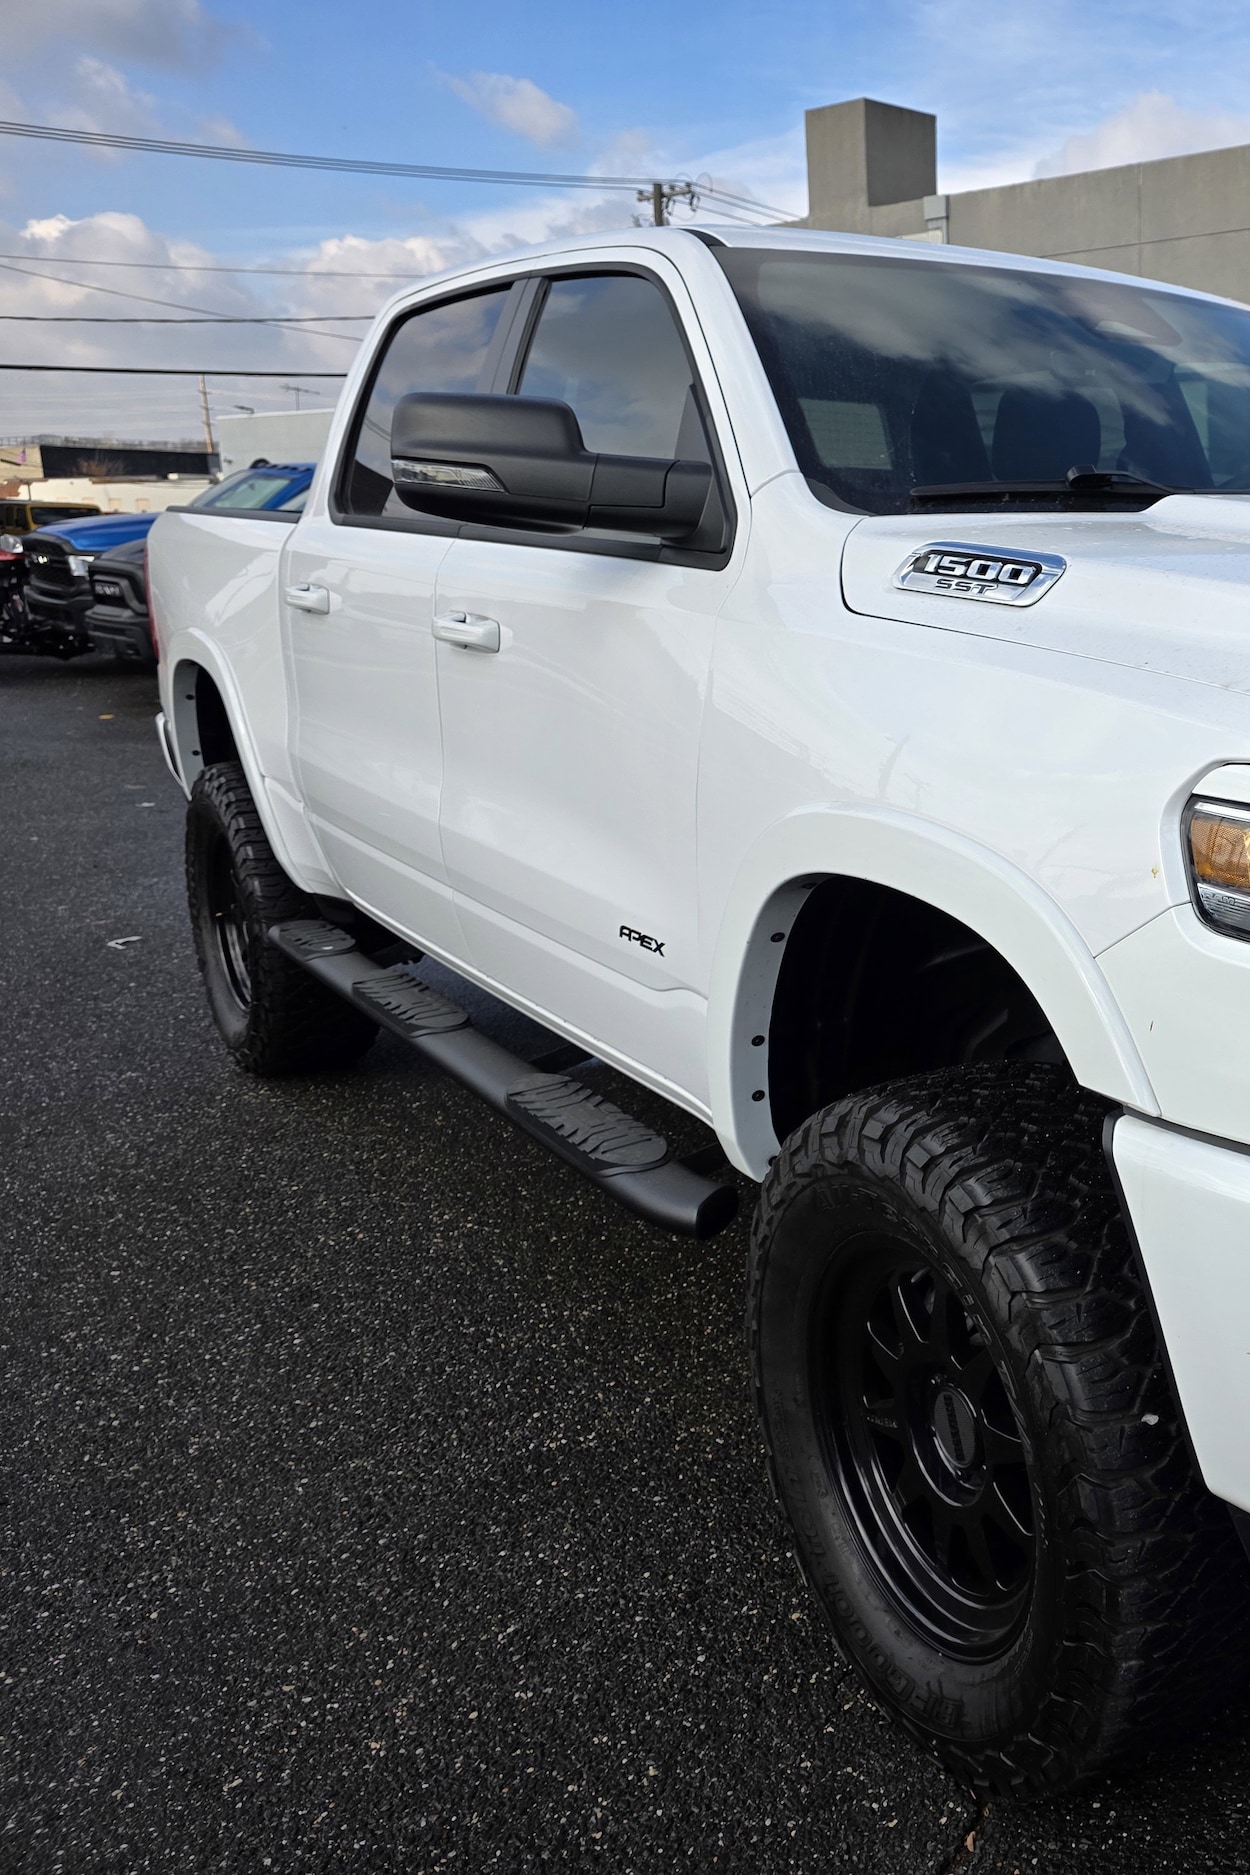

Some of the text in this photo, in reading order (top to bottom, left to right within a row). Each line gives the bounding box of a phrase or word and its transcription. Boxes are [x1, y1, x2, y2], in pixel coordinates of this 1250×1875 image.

[924, 554, 1036, 585] 1500
[936, 578, 998, 595] SST
[619, 925, 666, 957] APEX
